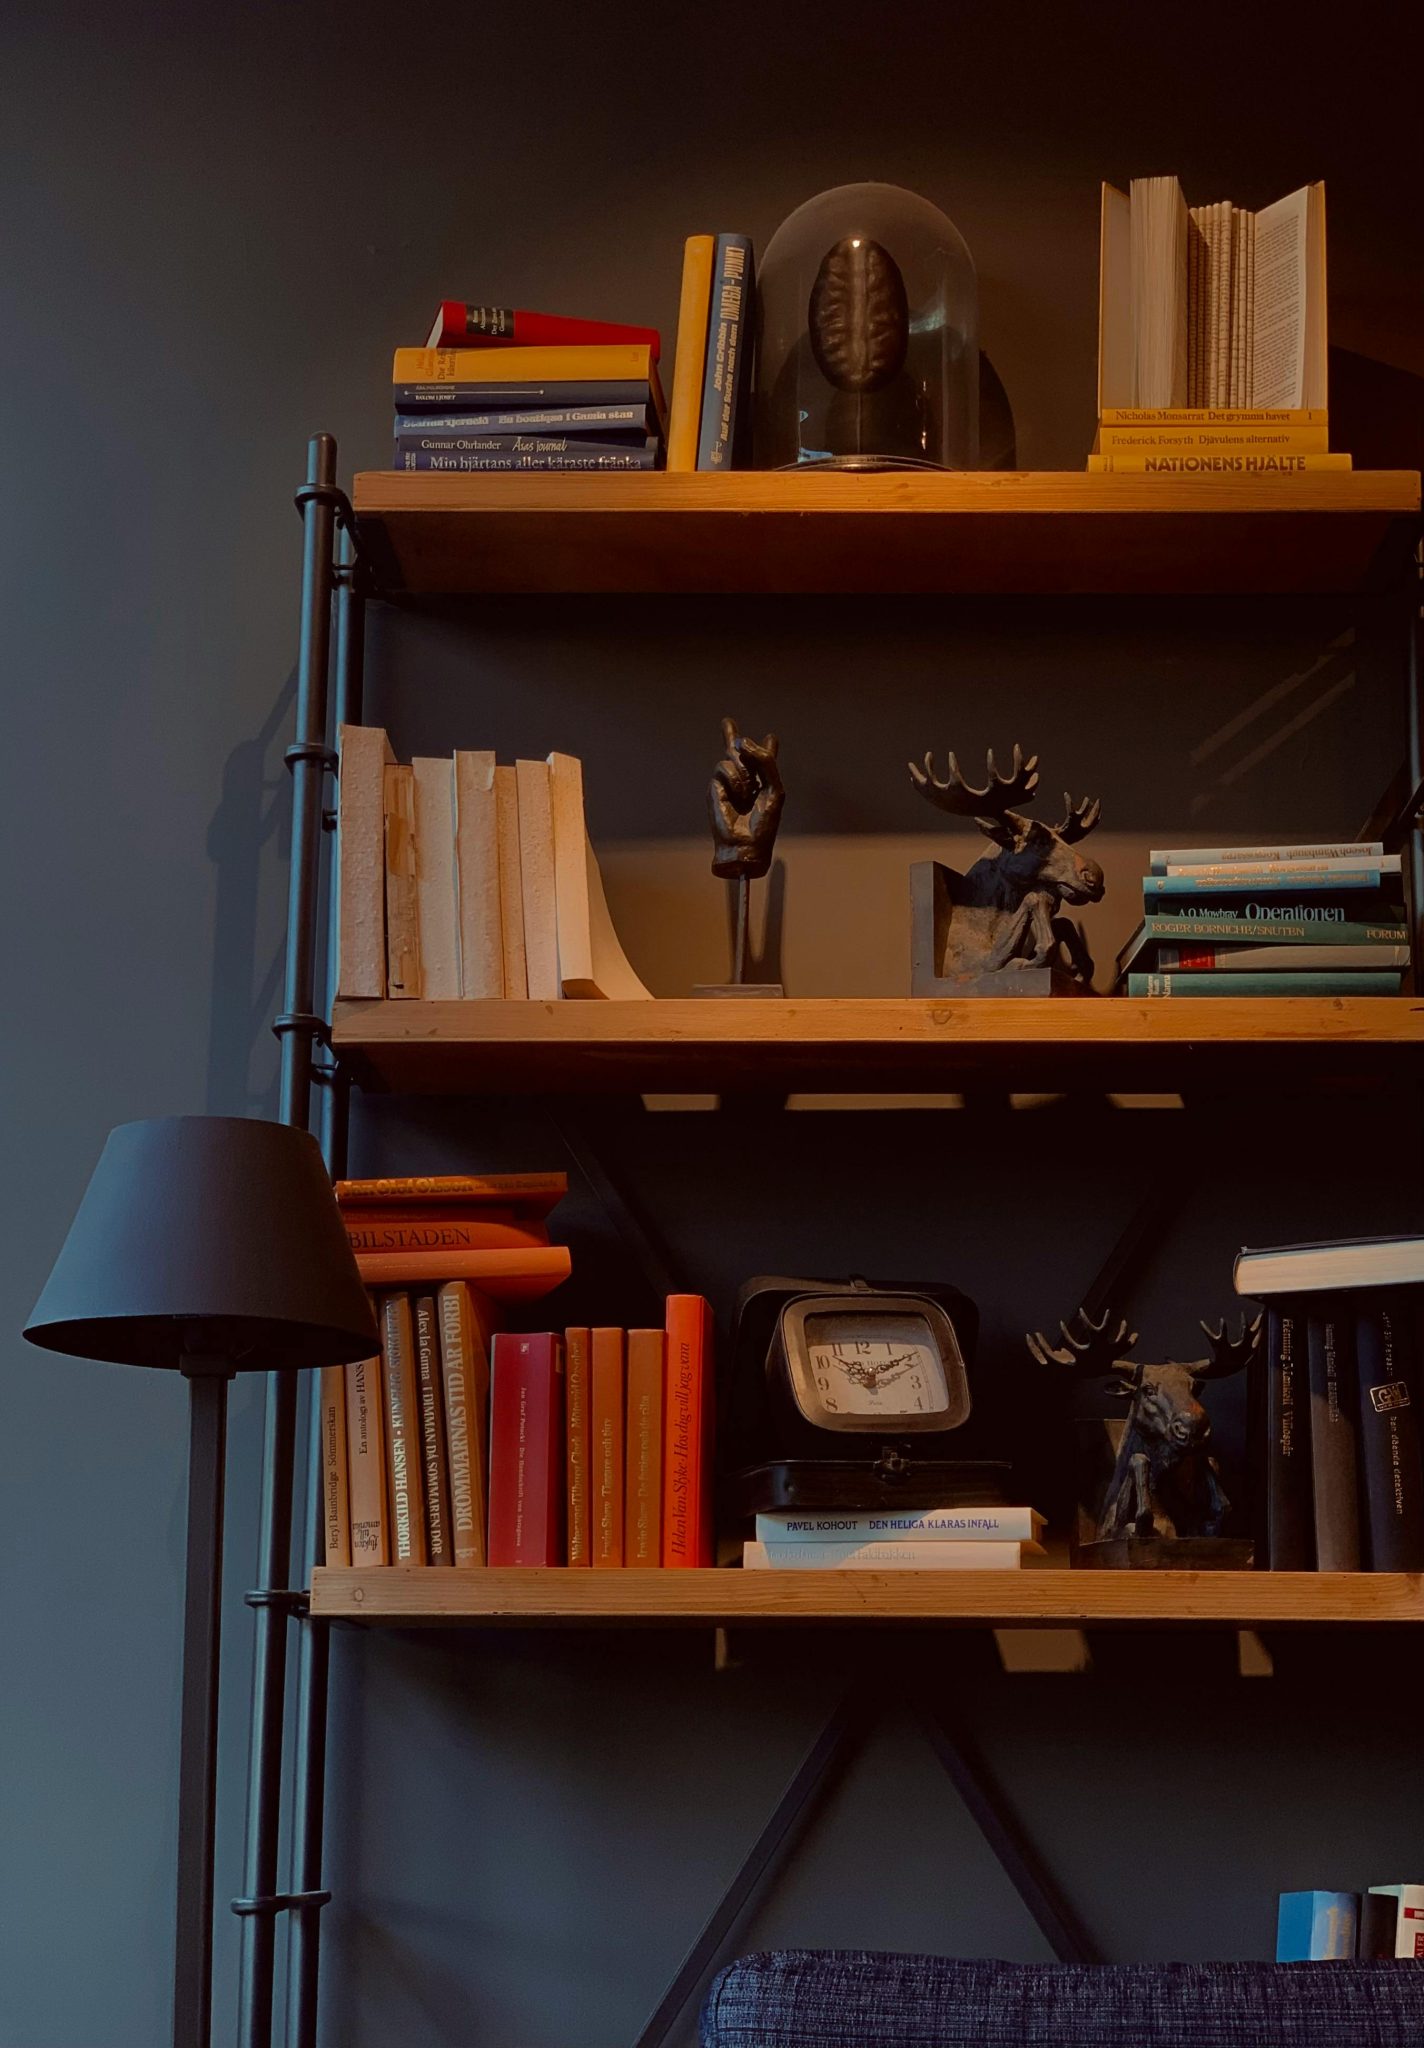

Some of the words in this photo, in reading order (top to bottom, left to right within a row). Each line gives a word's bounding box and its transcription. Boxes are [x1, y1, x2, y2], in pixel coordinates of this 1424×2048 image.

[716, 322, 727, 363] Gribbin
[729, 323, 738, 347] dem
[727, 347, 737, 373] nach
[713, 364, 724, 392] John
[722, 403, 731, 422] der
[1115, 410, 1157, 420] Nicholas
[1157, 411, 1205, 420] Monsarrat
[1208, 411, 1226, 420] Det
[1226, 412, 1265, 422] grymma
[1265, 411, 1291, 420] havet
[421, 440, 456, 450] Gunnar
[456, 440, 502, 450] Ohrlander
[536, 436, 568, 453] journal
[1112, 435, 1157, 446] Frederick
[1158, 435, 1194, 446] Forsyth
[1246, 434, 1291, 444] alternativ
[430, 457, 457, 470] Min
[460, 456, 512, 473] hjärtans
[516, 456, 546, 470] aller
[548, 456, 596, 470] käraste
[1145, 456, 1244, 472] NATIONENS
[1246, 454, 1307, 472] HJÄLTE
[1199, 908, 1239, 919] Mowbray
[1244, 902, 1345, 921] Operationen
[1151, 922, 1191, 933] ROGER
[1366, 929, 1407, 940] FORUM
[349, 1227, 471, 1249] BILSTADEN
[417, 1310, 430, 1334] Alex
[441, 1294, 462, 1343] FÖRBI
[419, 1335, 431, 1347] la
[855, 1340, 872, 1355] 12
[420, 1348, 432, 1381] Guma
[679, 1342, 690, 1371] vara
[815, 1354, 831, 1370] 10
[355, 1363, 366, 1393] HANS
[447, 1373, 465, 1405] TID
[674, 1372, 693, 1393] jag
[818, 1376, 830, 1391] 9
[910, 1374, 922, 1390] 3
[360, 1394, 366, 1404] av
[825, 1397, 839, 1412] 8
[913, 1396, 924, 1411] 4
[358, 1405, 369, 1439] antologi
[422, 1393, 437, 1443] DIMMAN
[673, 1414, 692, 1433] dig
[359, 1441, 368, 1455] En
[425, 1445, 439, 1460] DÅ
[673, 1433, 689, 1458] Hos
[392, 1438, 408, 1490] HANSEN
[449, 1405, 474, 1532] DRÖMMARNAS
[672, 1462, 691, 1495] Slyke
[328, 1472, 339, 1521] Bainbridge
[427, 1461, 441, 1528] SOMMAREN
[1393, 1468, 1404, 1515] detektiven
[671, 1496, 687, 1518] Van
[395, 1491, 411, 1560] THORKILD
[786, 1521, 814, 1531] PAVEL
[817, 1520, 858, 1530] KOHOUT
[868, 1520, 889, 1530] DEN
[890, 1519, 925, 1530] HELIGA
[928, 1519, 966, 1529] KLARAS
[967, 1519, 1000, 1531] INFALL
[329, 1524, 340, 1549] Beryl
[671, 1519, 687, 1556] Helen
